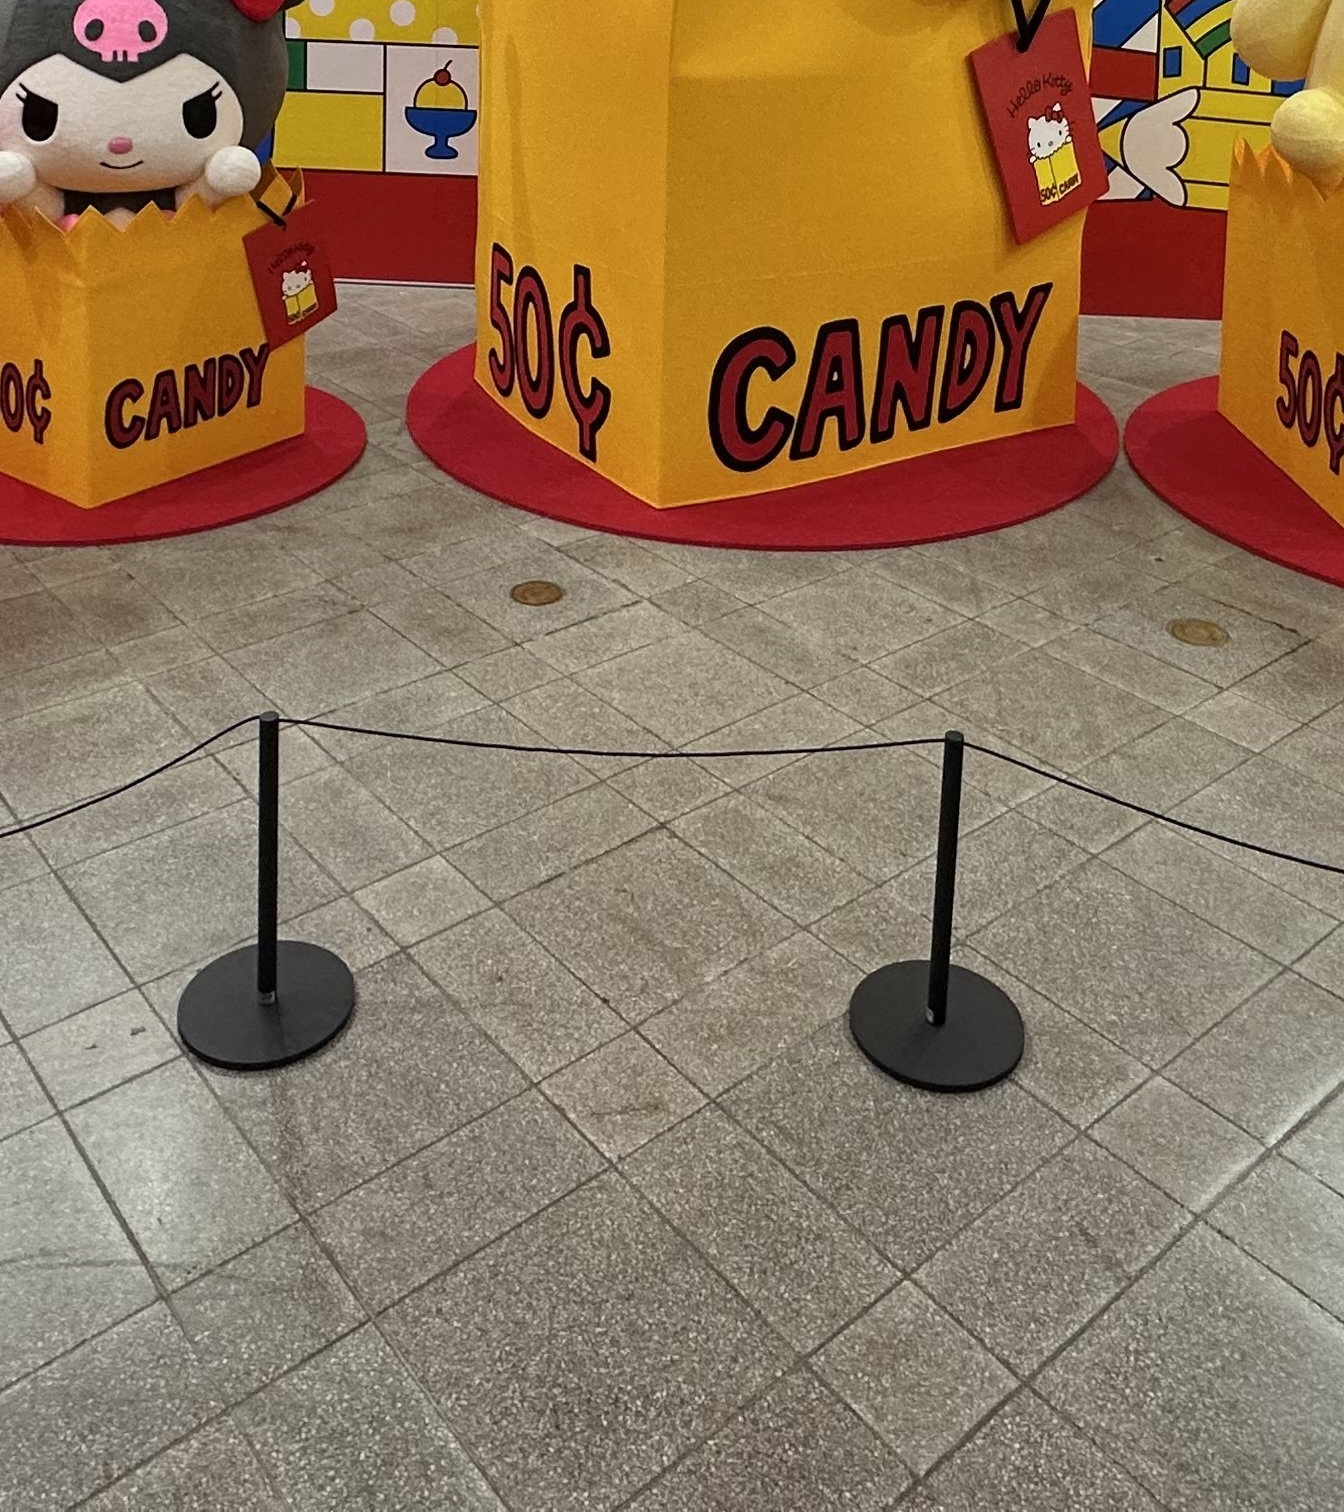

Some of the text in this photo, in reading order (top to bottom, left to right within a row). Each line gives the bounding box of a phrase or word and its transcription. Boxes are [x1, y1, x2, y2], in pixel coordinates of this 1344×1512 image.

[1007, 72, 1073, 117] Hello Kitty
[104, 342, 270, 450] CANDY
[489, 242, 1053, 472] 50¢ CANDY
